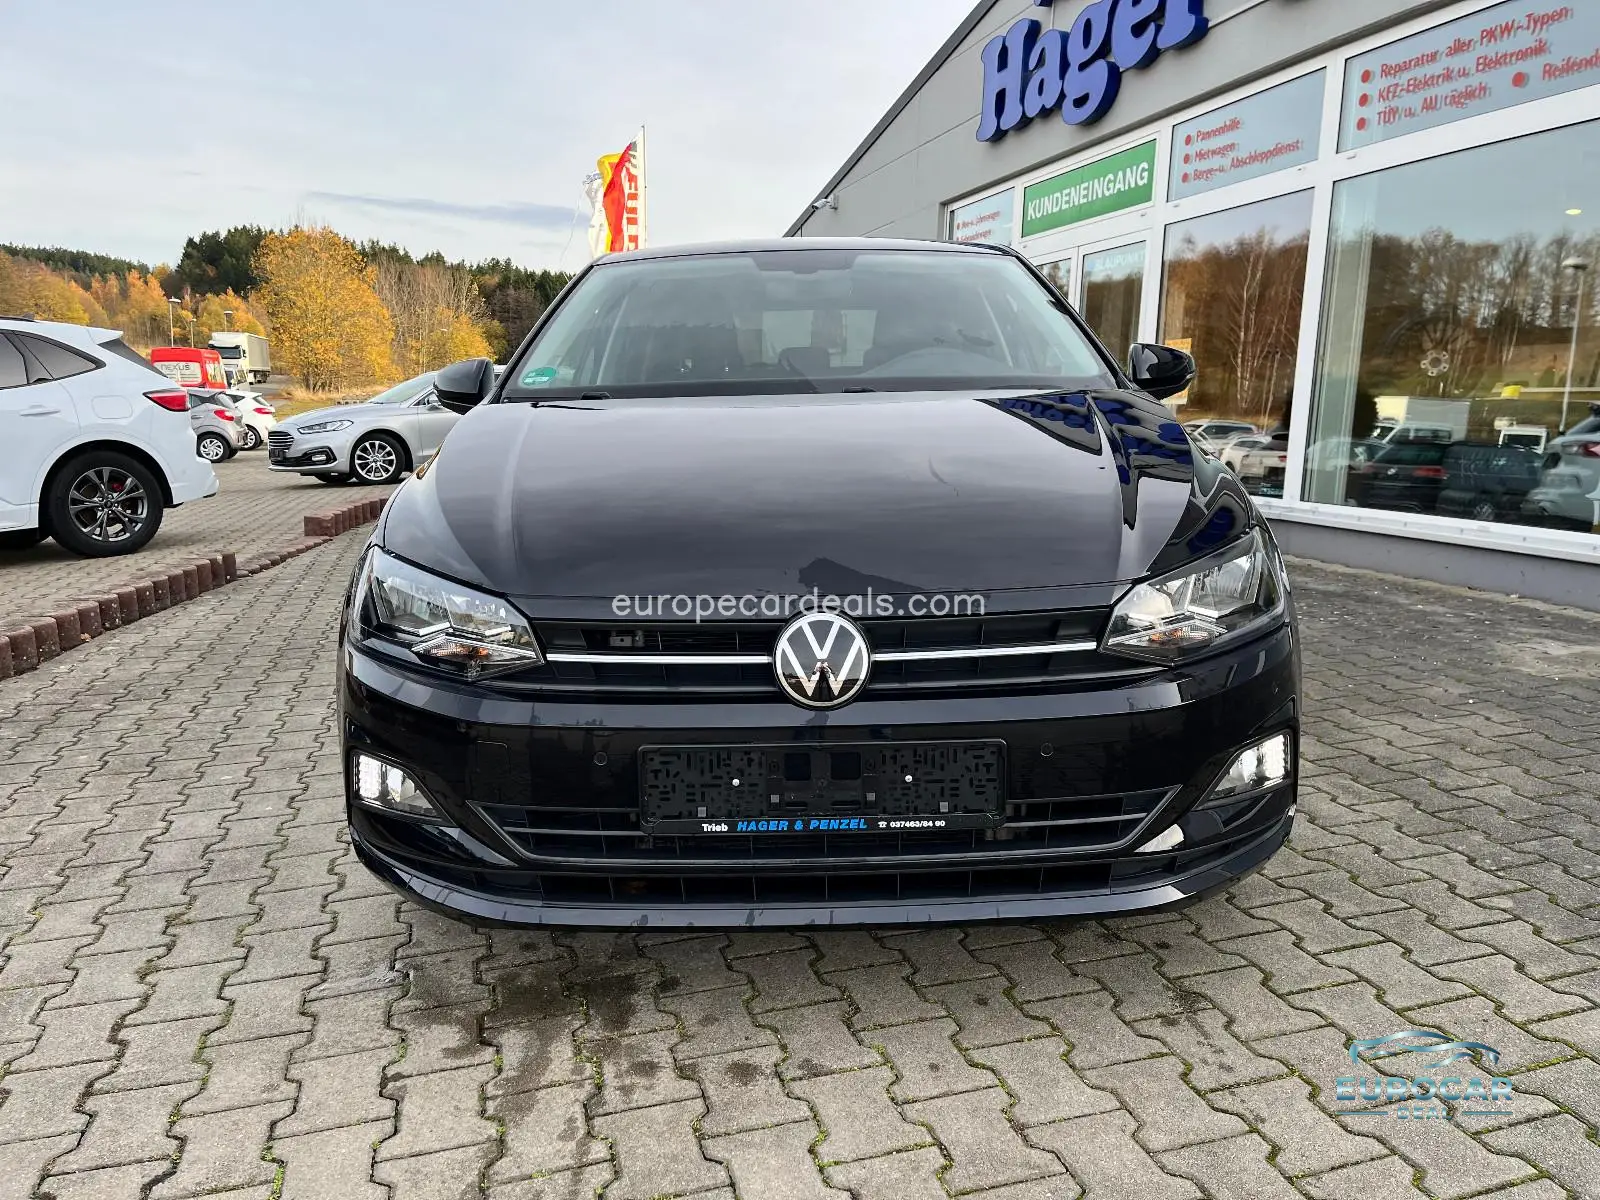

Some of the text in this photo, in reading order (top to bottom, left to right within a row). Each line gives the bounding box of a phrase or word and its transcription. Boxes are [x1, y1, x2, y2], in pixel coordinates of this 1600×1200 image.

[1378, 66, 1454, 103] KFZ-Elektrik
[1475, 37, 1548, 74] Elektronik
[1380, 50, 1440, 79] Reparatur
[1445, 38, 1476, 58] aller
[1377, 105, 1399, 126] TÜV
[1421, 93, 1439, 113] AU
[1196, 117, 1242, 143] Pannenhilfe
[1230, 139, 1301, 170] Abschleppdienst
[1027, 161, 1149, 220] KUNDENEINGANG
[701, 822, 729, 833] Trieb
[736, 819, 788, 832] HAGER
[794, 819, 804, 832] &
[809, 818, 868, 831] PENZEL
